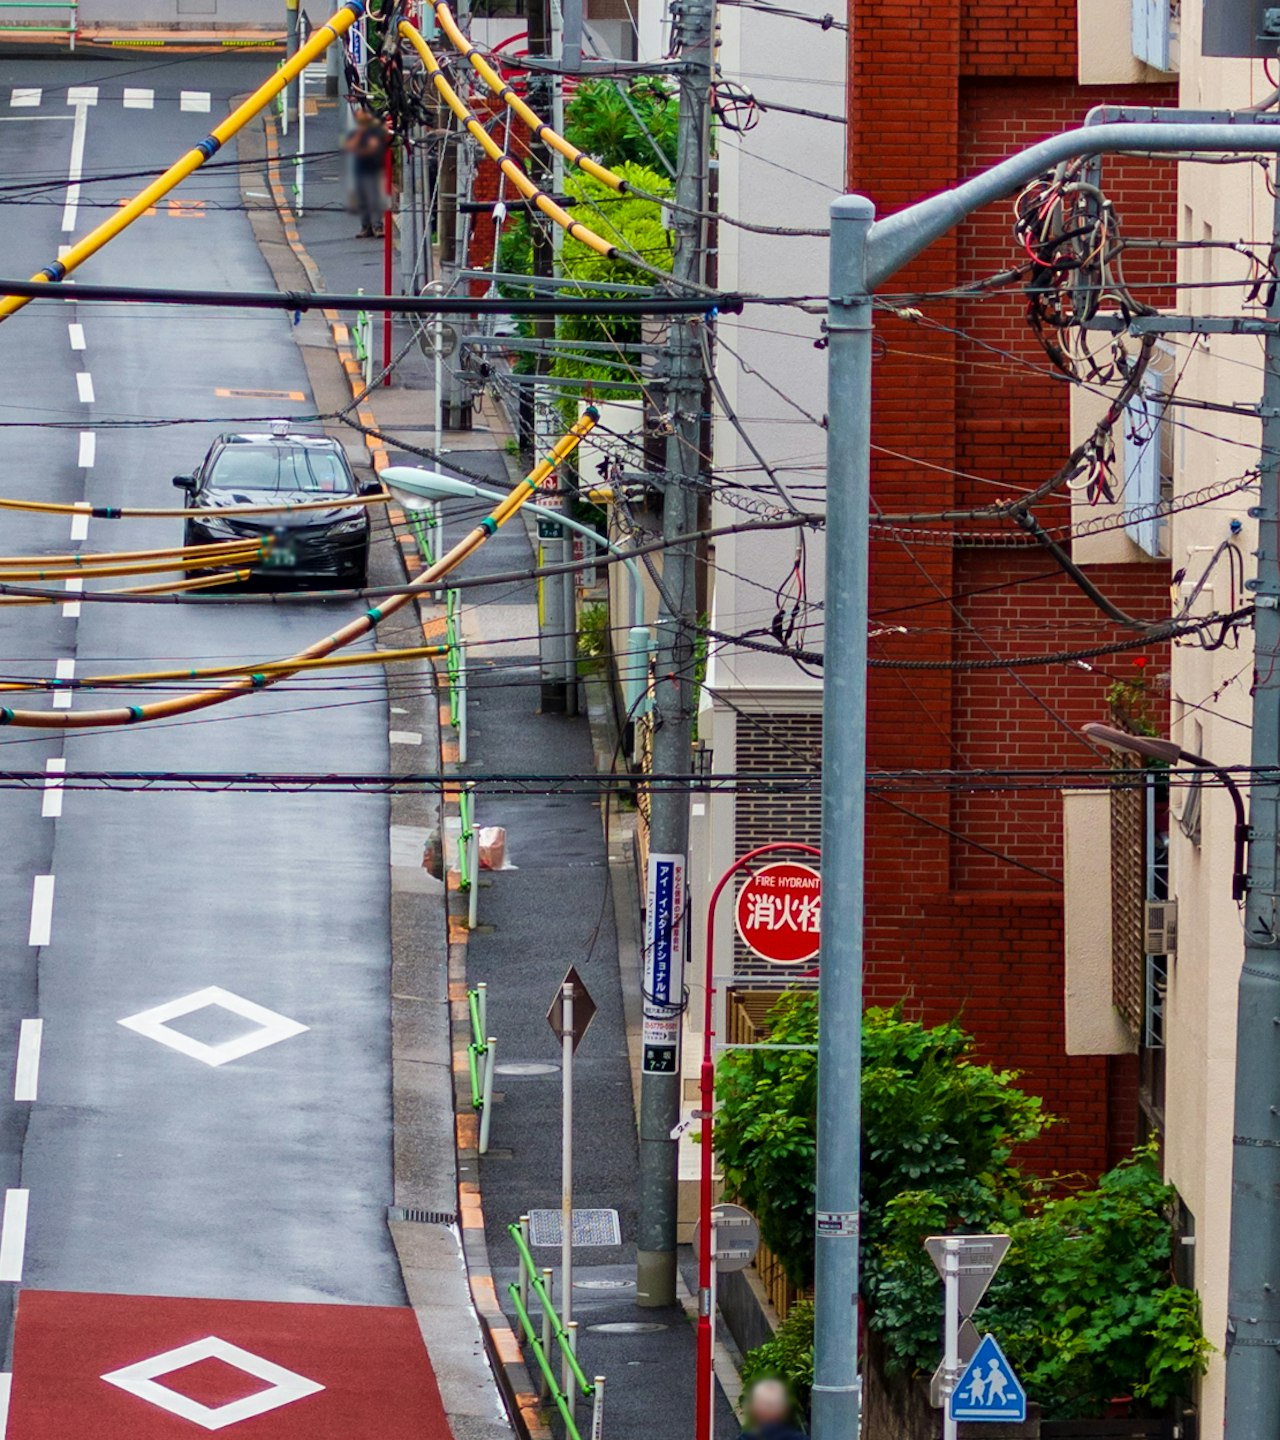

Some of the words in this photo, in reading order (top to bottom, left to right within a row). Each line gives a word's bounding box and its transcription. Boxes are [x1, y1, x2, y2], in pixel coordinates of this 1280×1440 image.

[755, 876, 776, 887] FIRE
[778, 877, 820, 889] HYDRANT
[746, 893, 821, 933] 消火栓
[649, 1061, 667, 1071] 7-7
